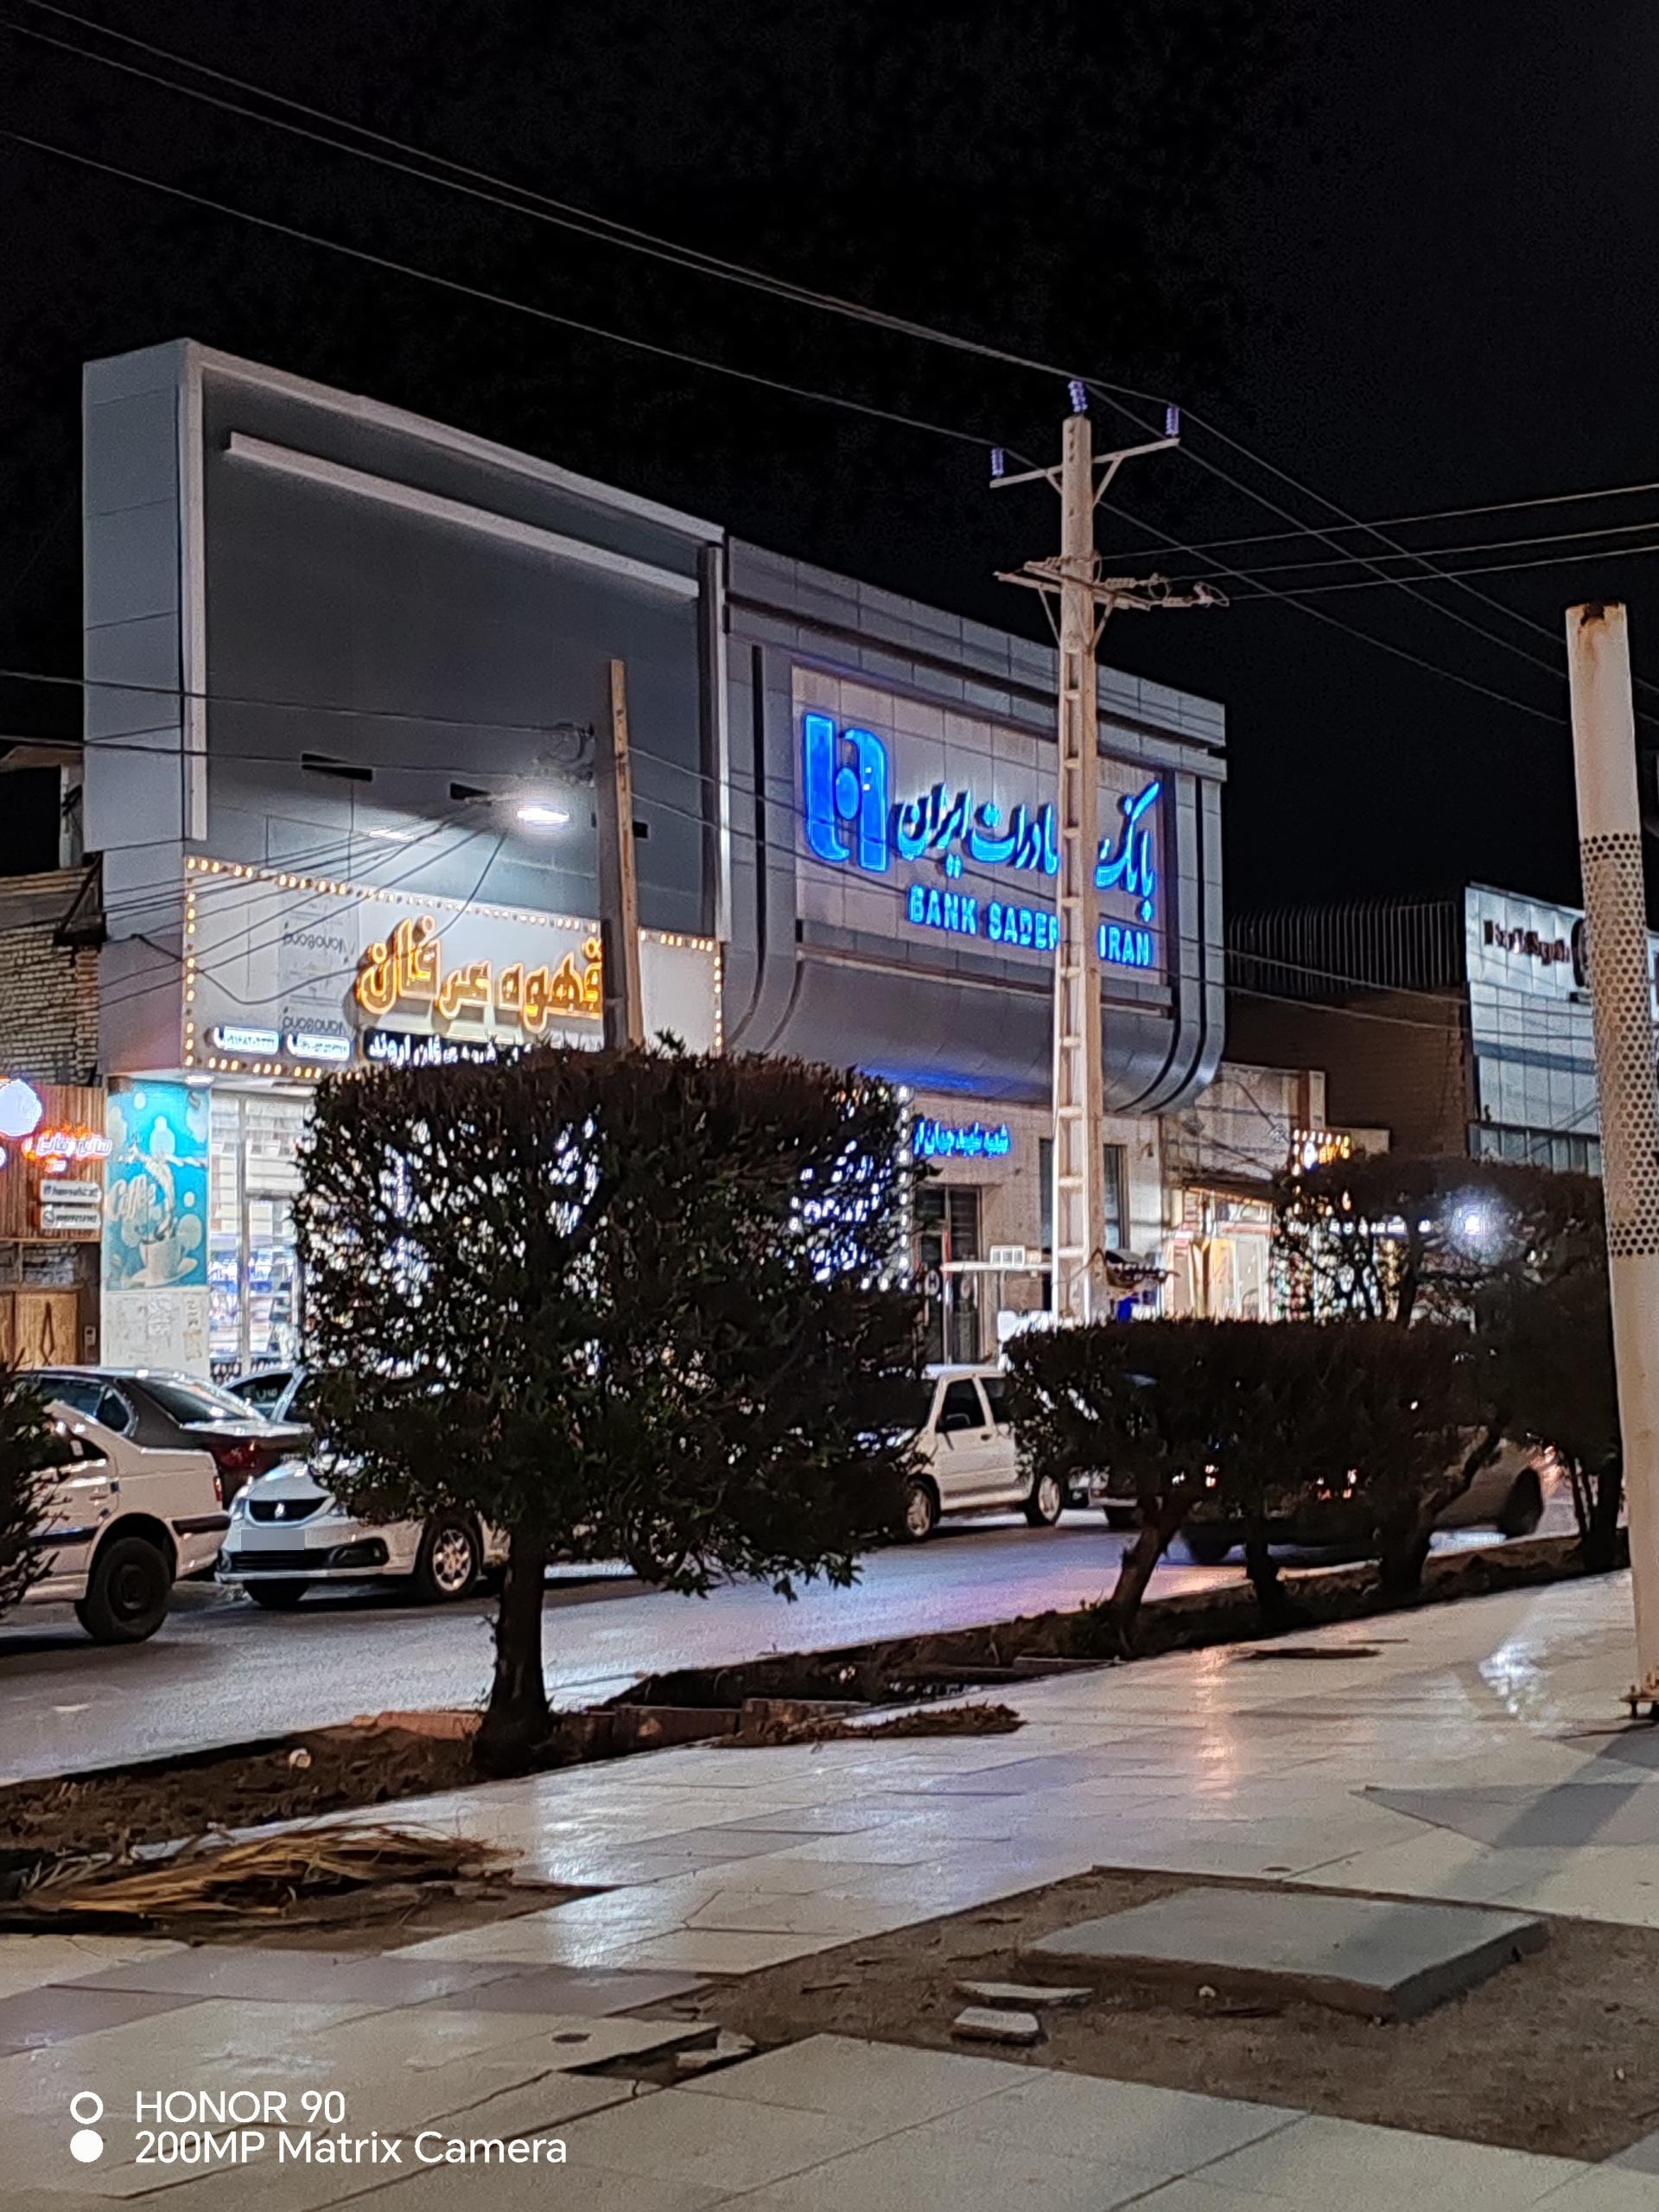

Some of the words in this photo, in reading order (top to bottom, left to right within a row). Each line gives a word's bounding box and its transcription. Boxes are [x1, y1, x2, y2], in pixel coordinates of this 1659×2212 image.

[895, 782, 971, 879] ایران
[1095, 780, 1160, 923] بانک
[354, 914, 493, 1020] عرفان
[907, 883, 977, 935] BANK
[988, 900, 1060, 950] SADER
[1098, 925, 1152, 967] IRAN
[498, 937, 602, 1033] قهوه
[107, 1173, 156, 1221] Coffee
